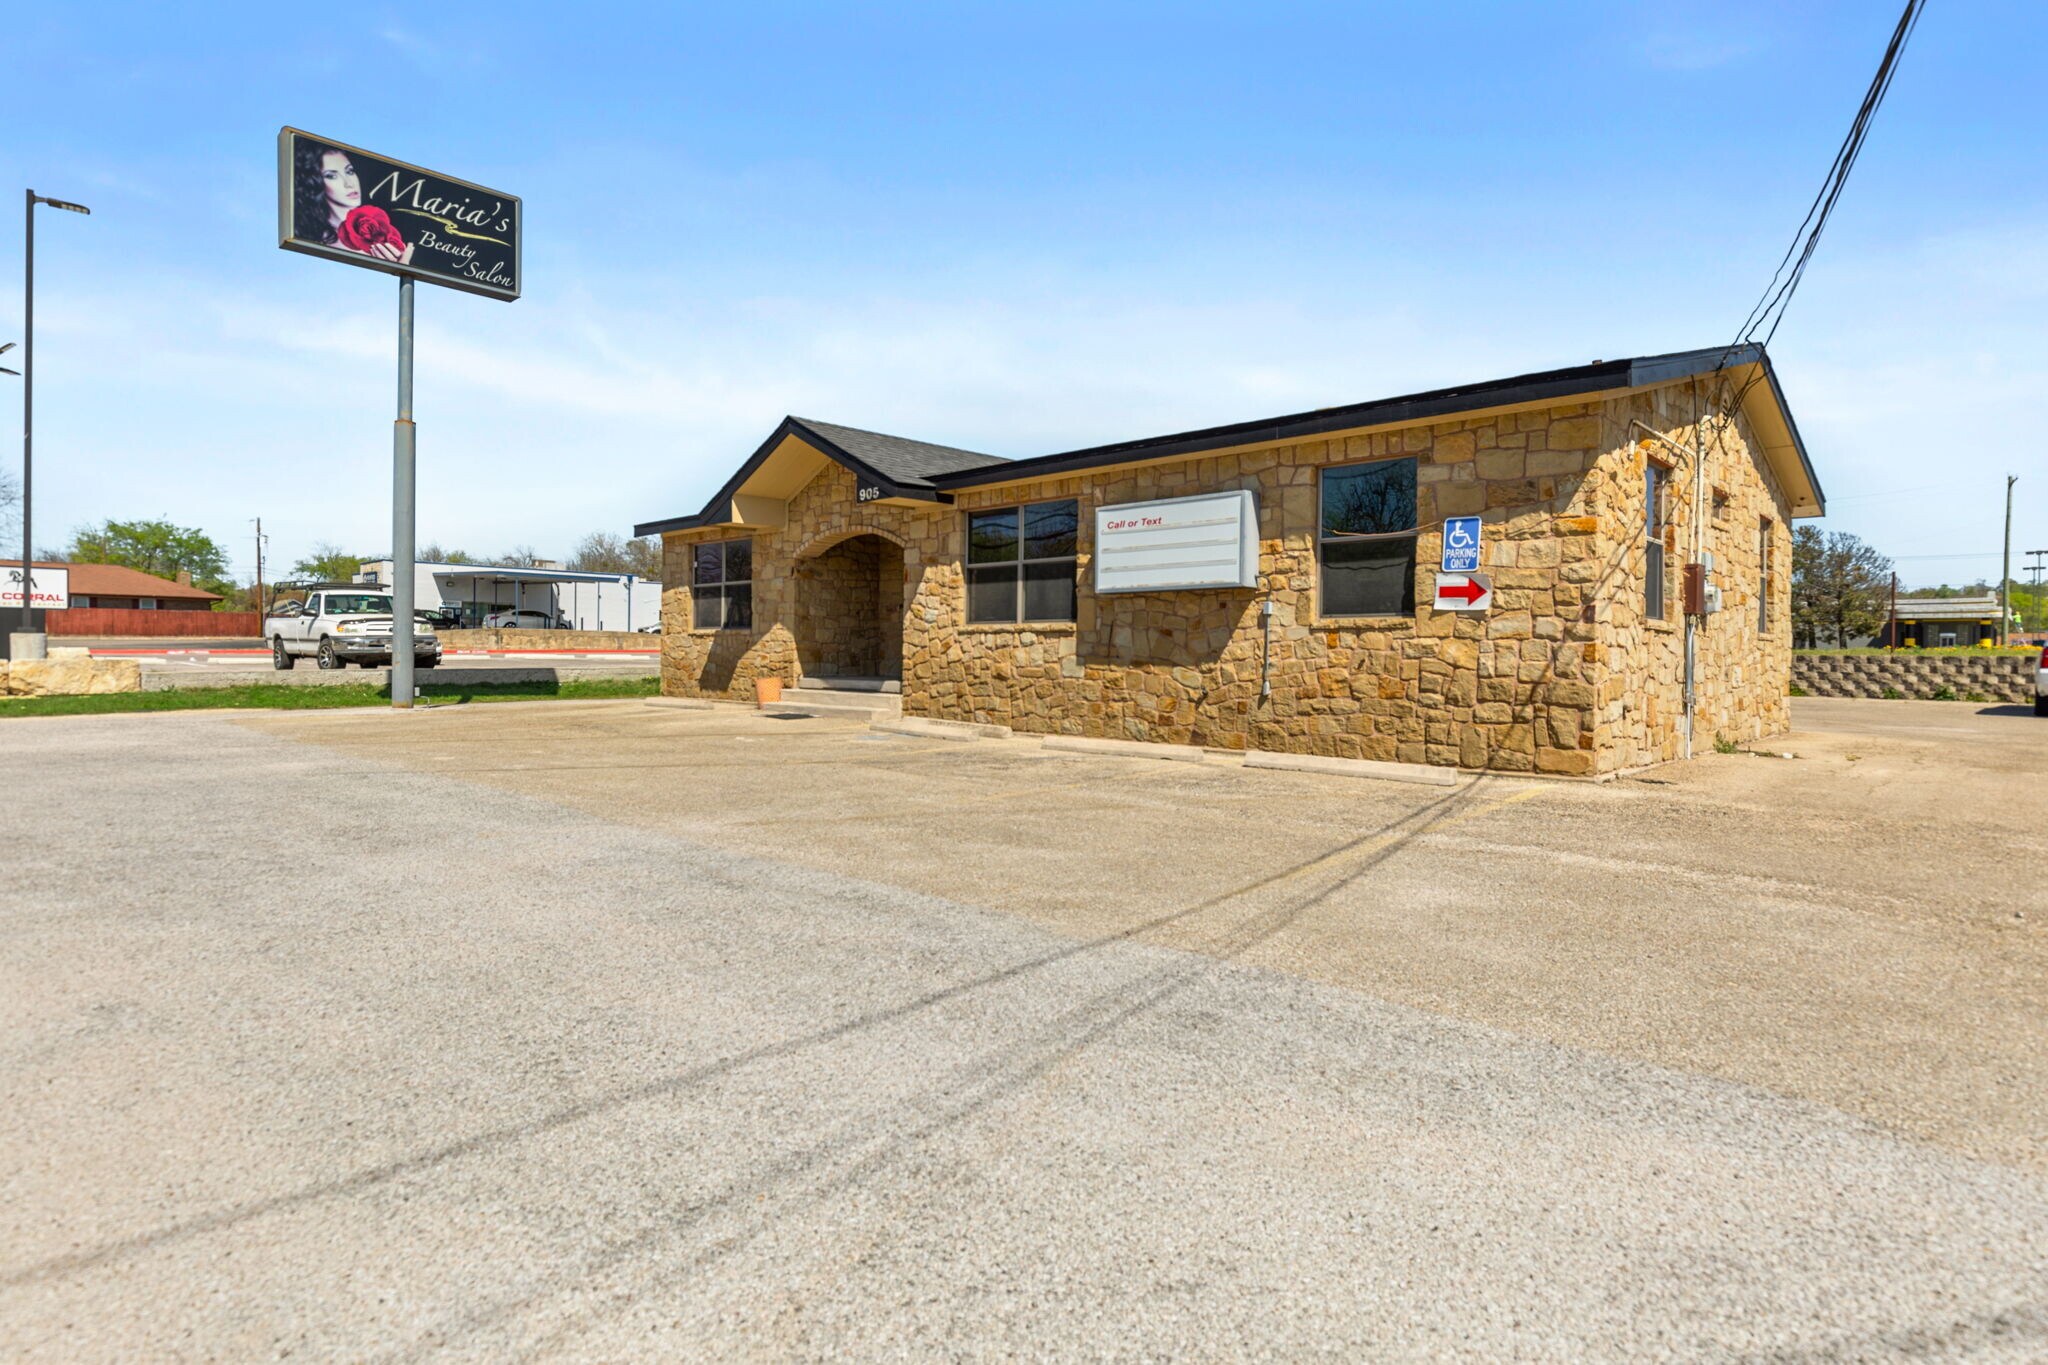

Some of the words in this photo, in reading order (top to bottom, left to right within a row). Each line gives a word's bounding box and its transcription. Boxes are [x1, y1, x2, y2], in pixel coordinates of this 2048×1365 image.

[369, 171, 510, 232] Maria's
[418, 229, 477, 268] Beauty
[463, 261, 514, 287] Salon
[859, 487, 879, 501] 905
[1107, 520, 1126, 530] Call
[1127, 520, 1138, 528] or
[1141, 517, 1162, 526] Text
[1446, 548, 1477, 558] PARKING
[1450, 559, 1470, 568] ONLY
